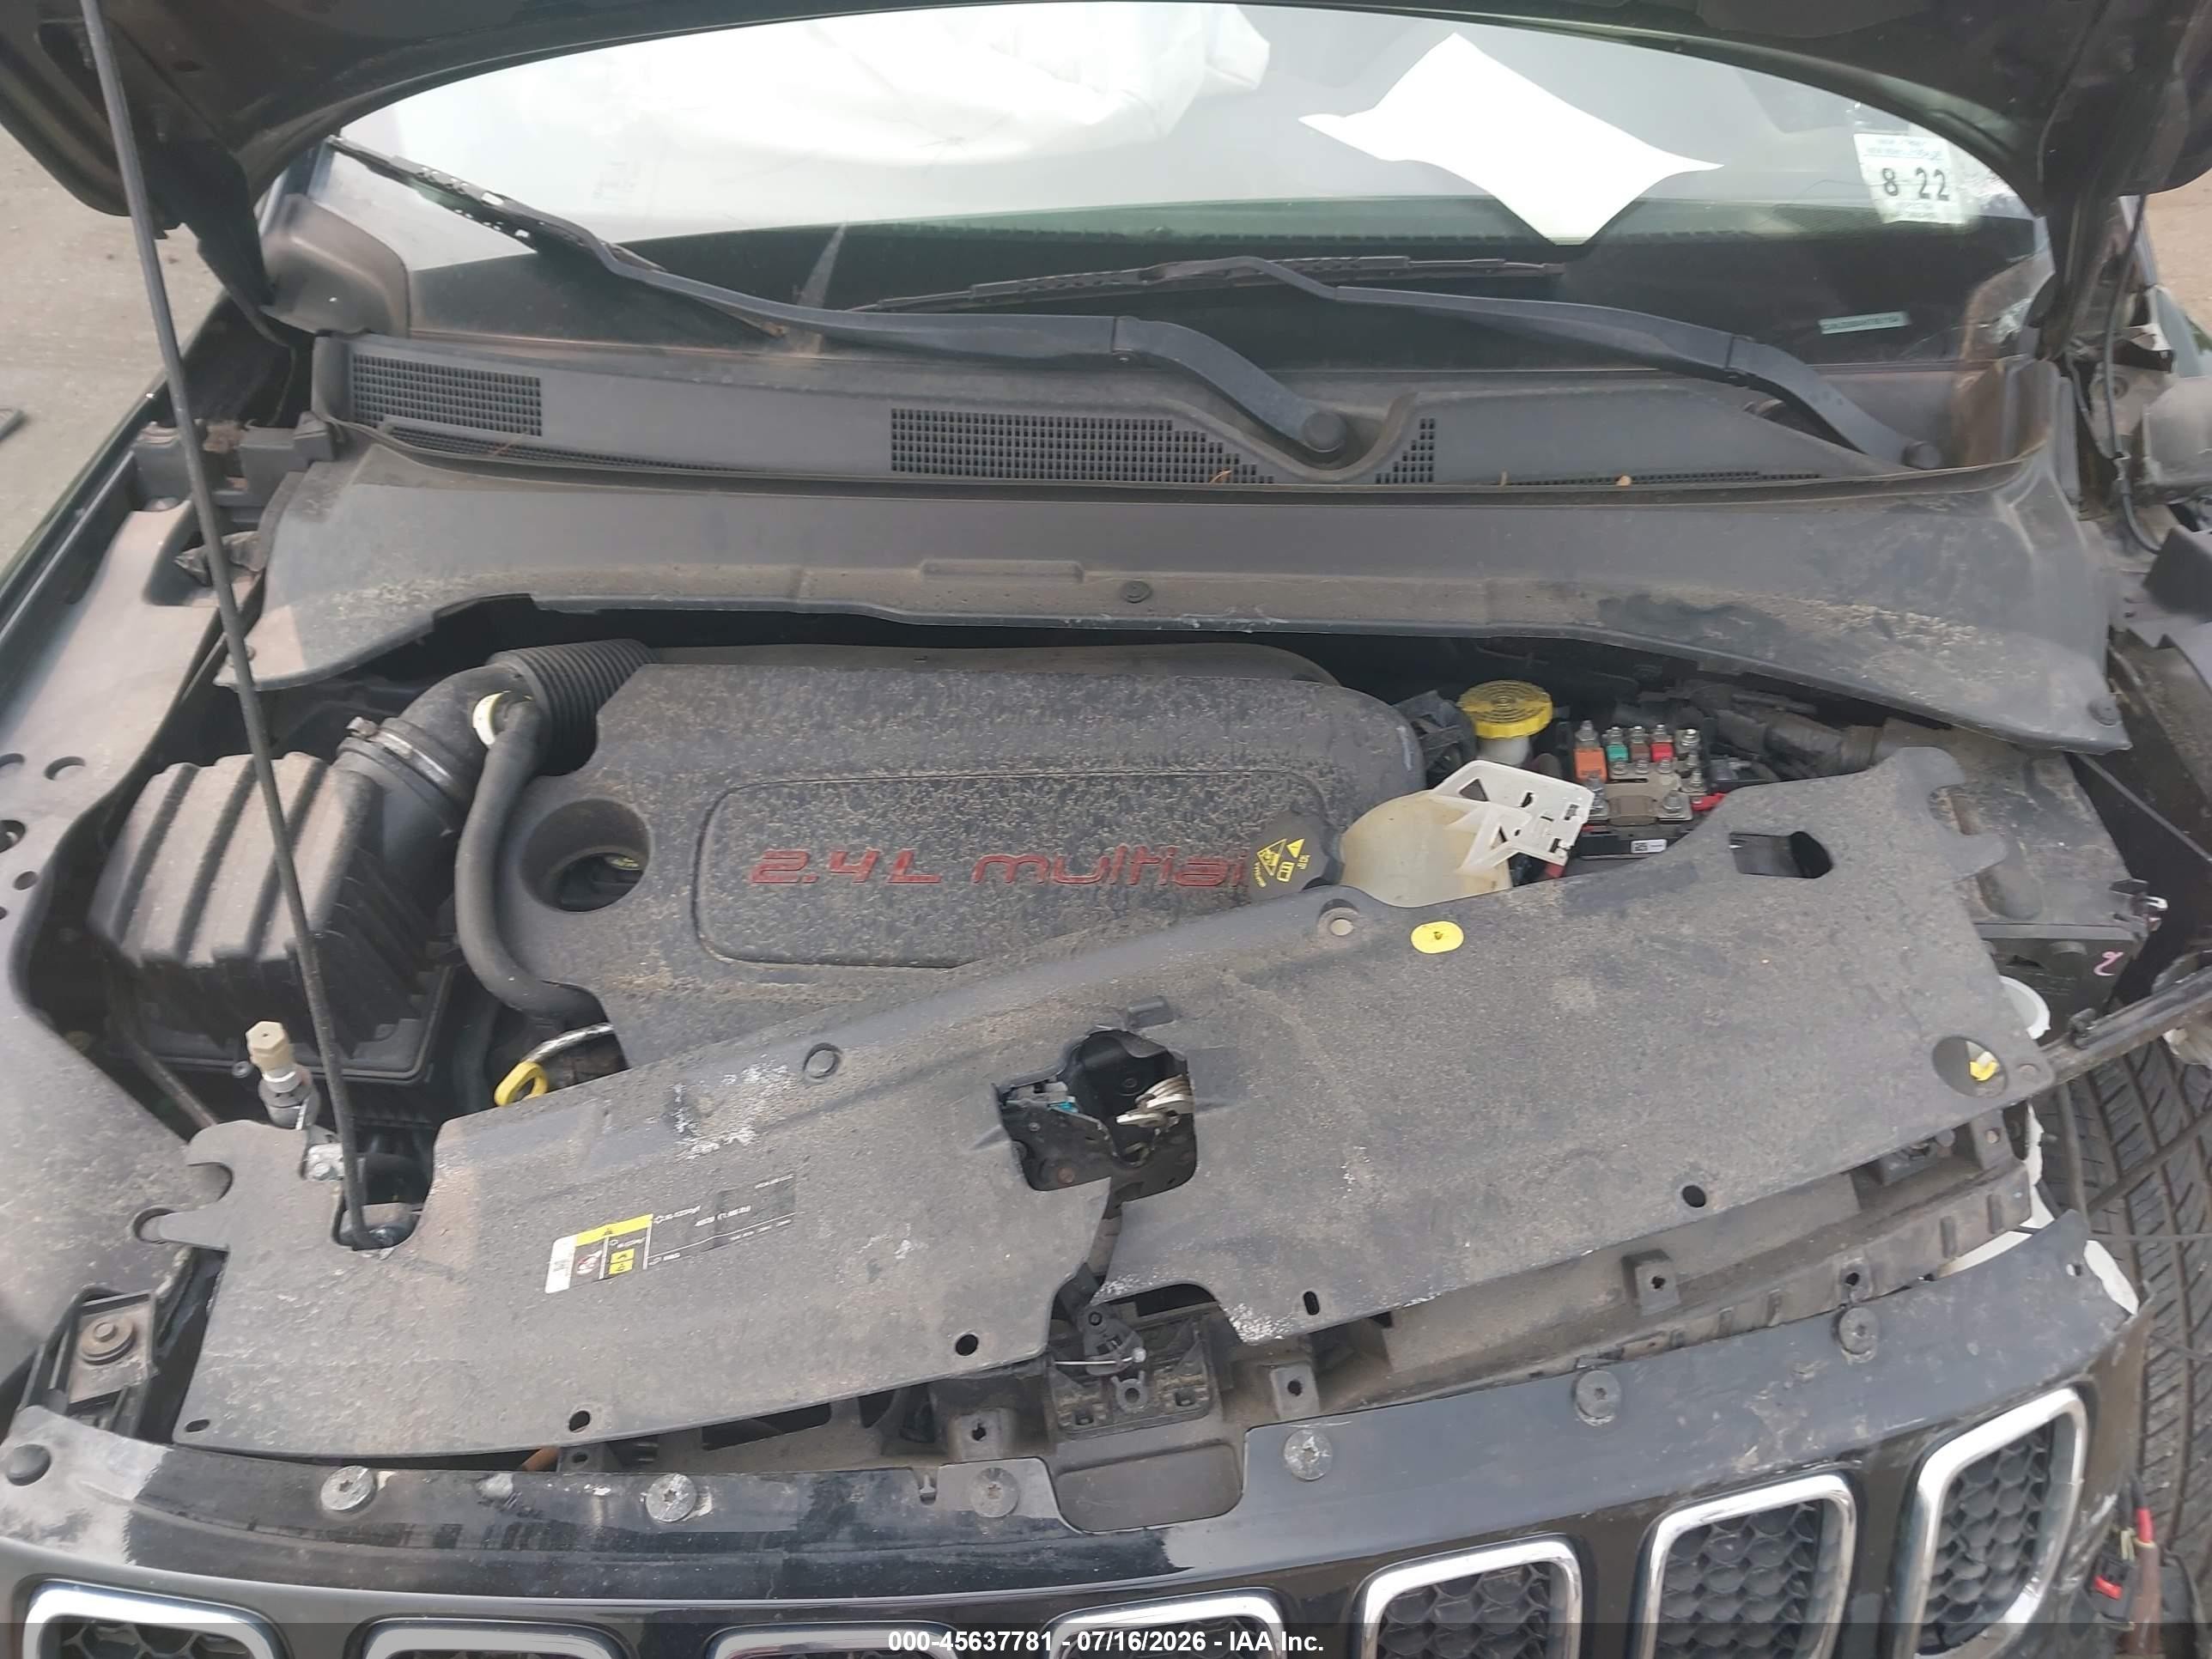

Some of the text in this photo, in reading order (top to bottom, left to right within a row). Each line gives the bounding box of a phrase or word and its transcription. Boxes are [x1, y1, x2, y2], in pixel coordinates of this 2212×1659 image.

[1882, 167, 1949, 201] 8 22
[971, 845, 1250, 886] multiai
